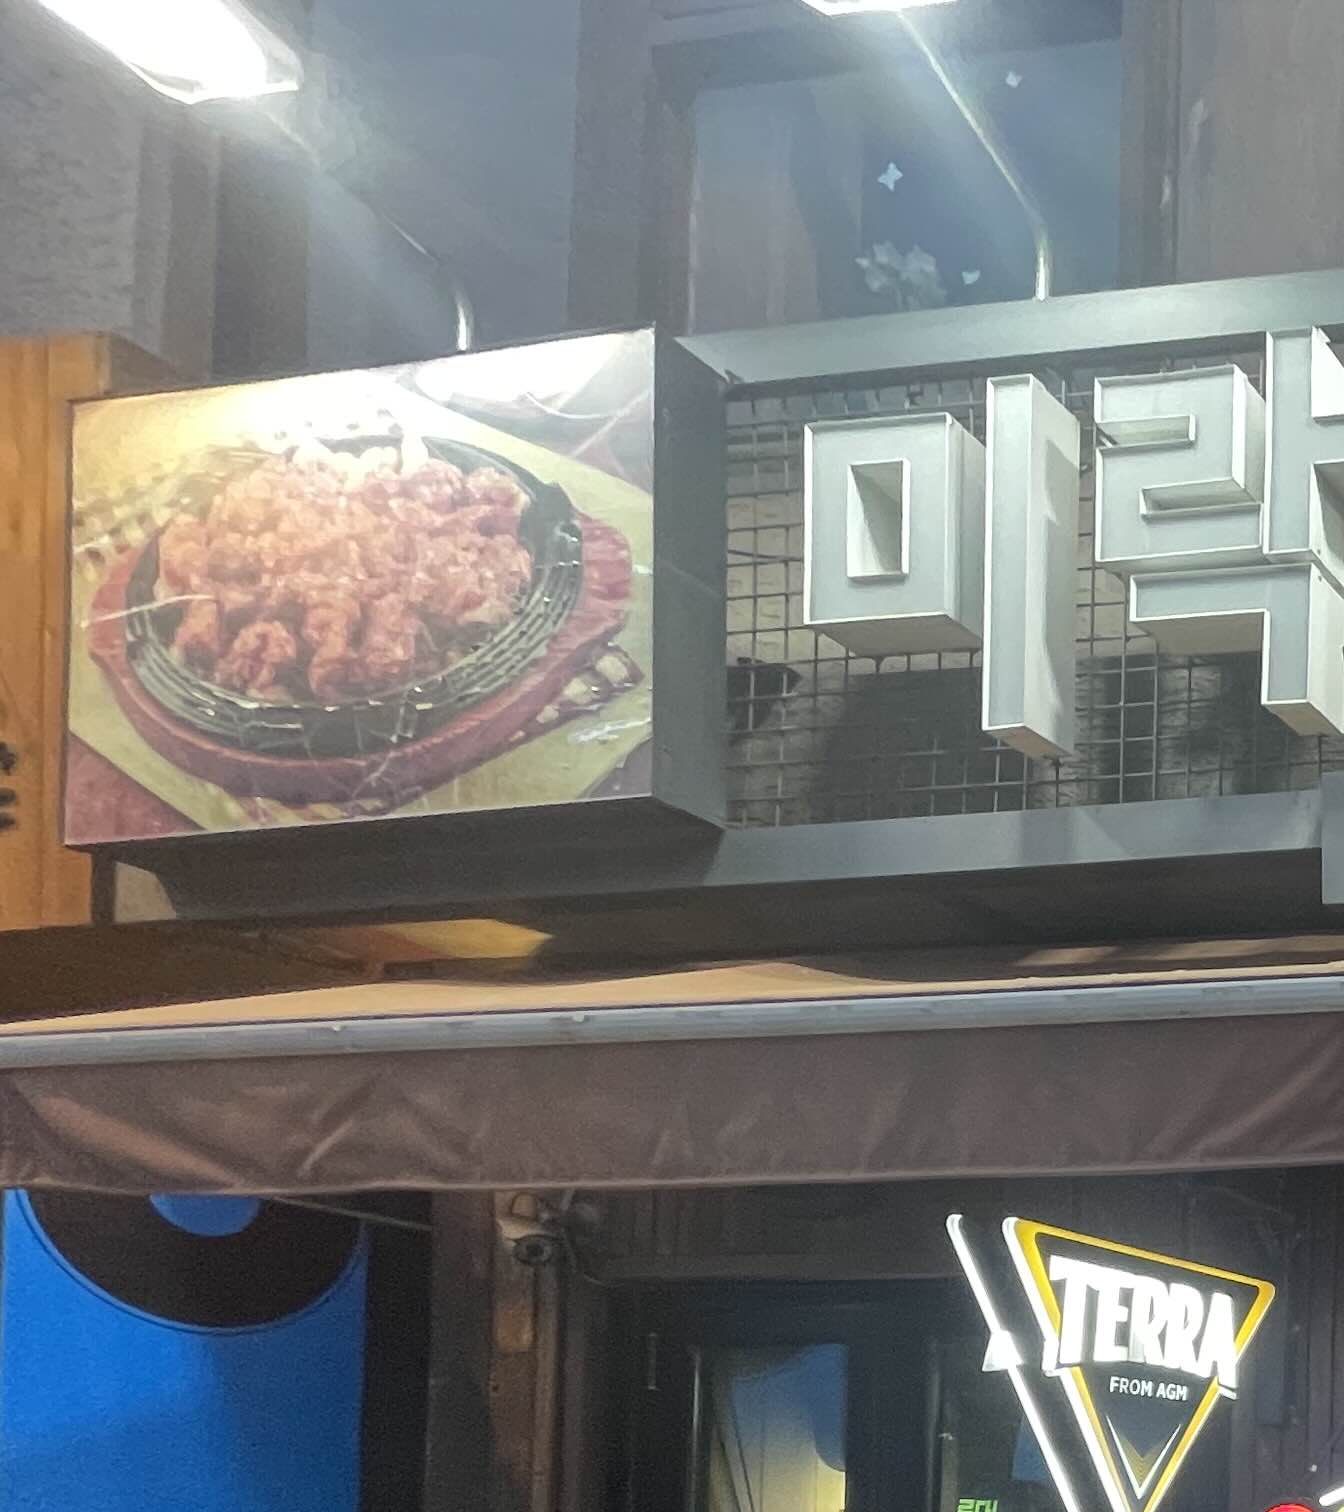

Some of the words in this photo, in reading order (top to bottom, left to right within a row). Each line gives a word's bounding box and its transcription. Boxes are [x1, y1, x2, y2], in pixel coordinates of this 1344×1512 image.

[1049, 1254, 1238, 1390] TERRA
[1108, 1376, 1151, 1398] FROM
[1155, 1380, 1188, 1401] AGM
